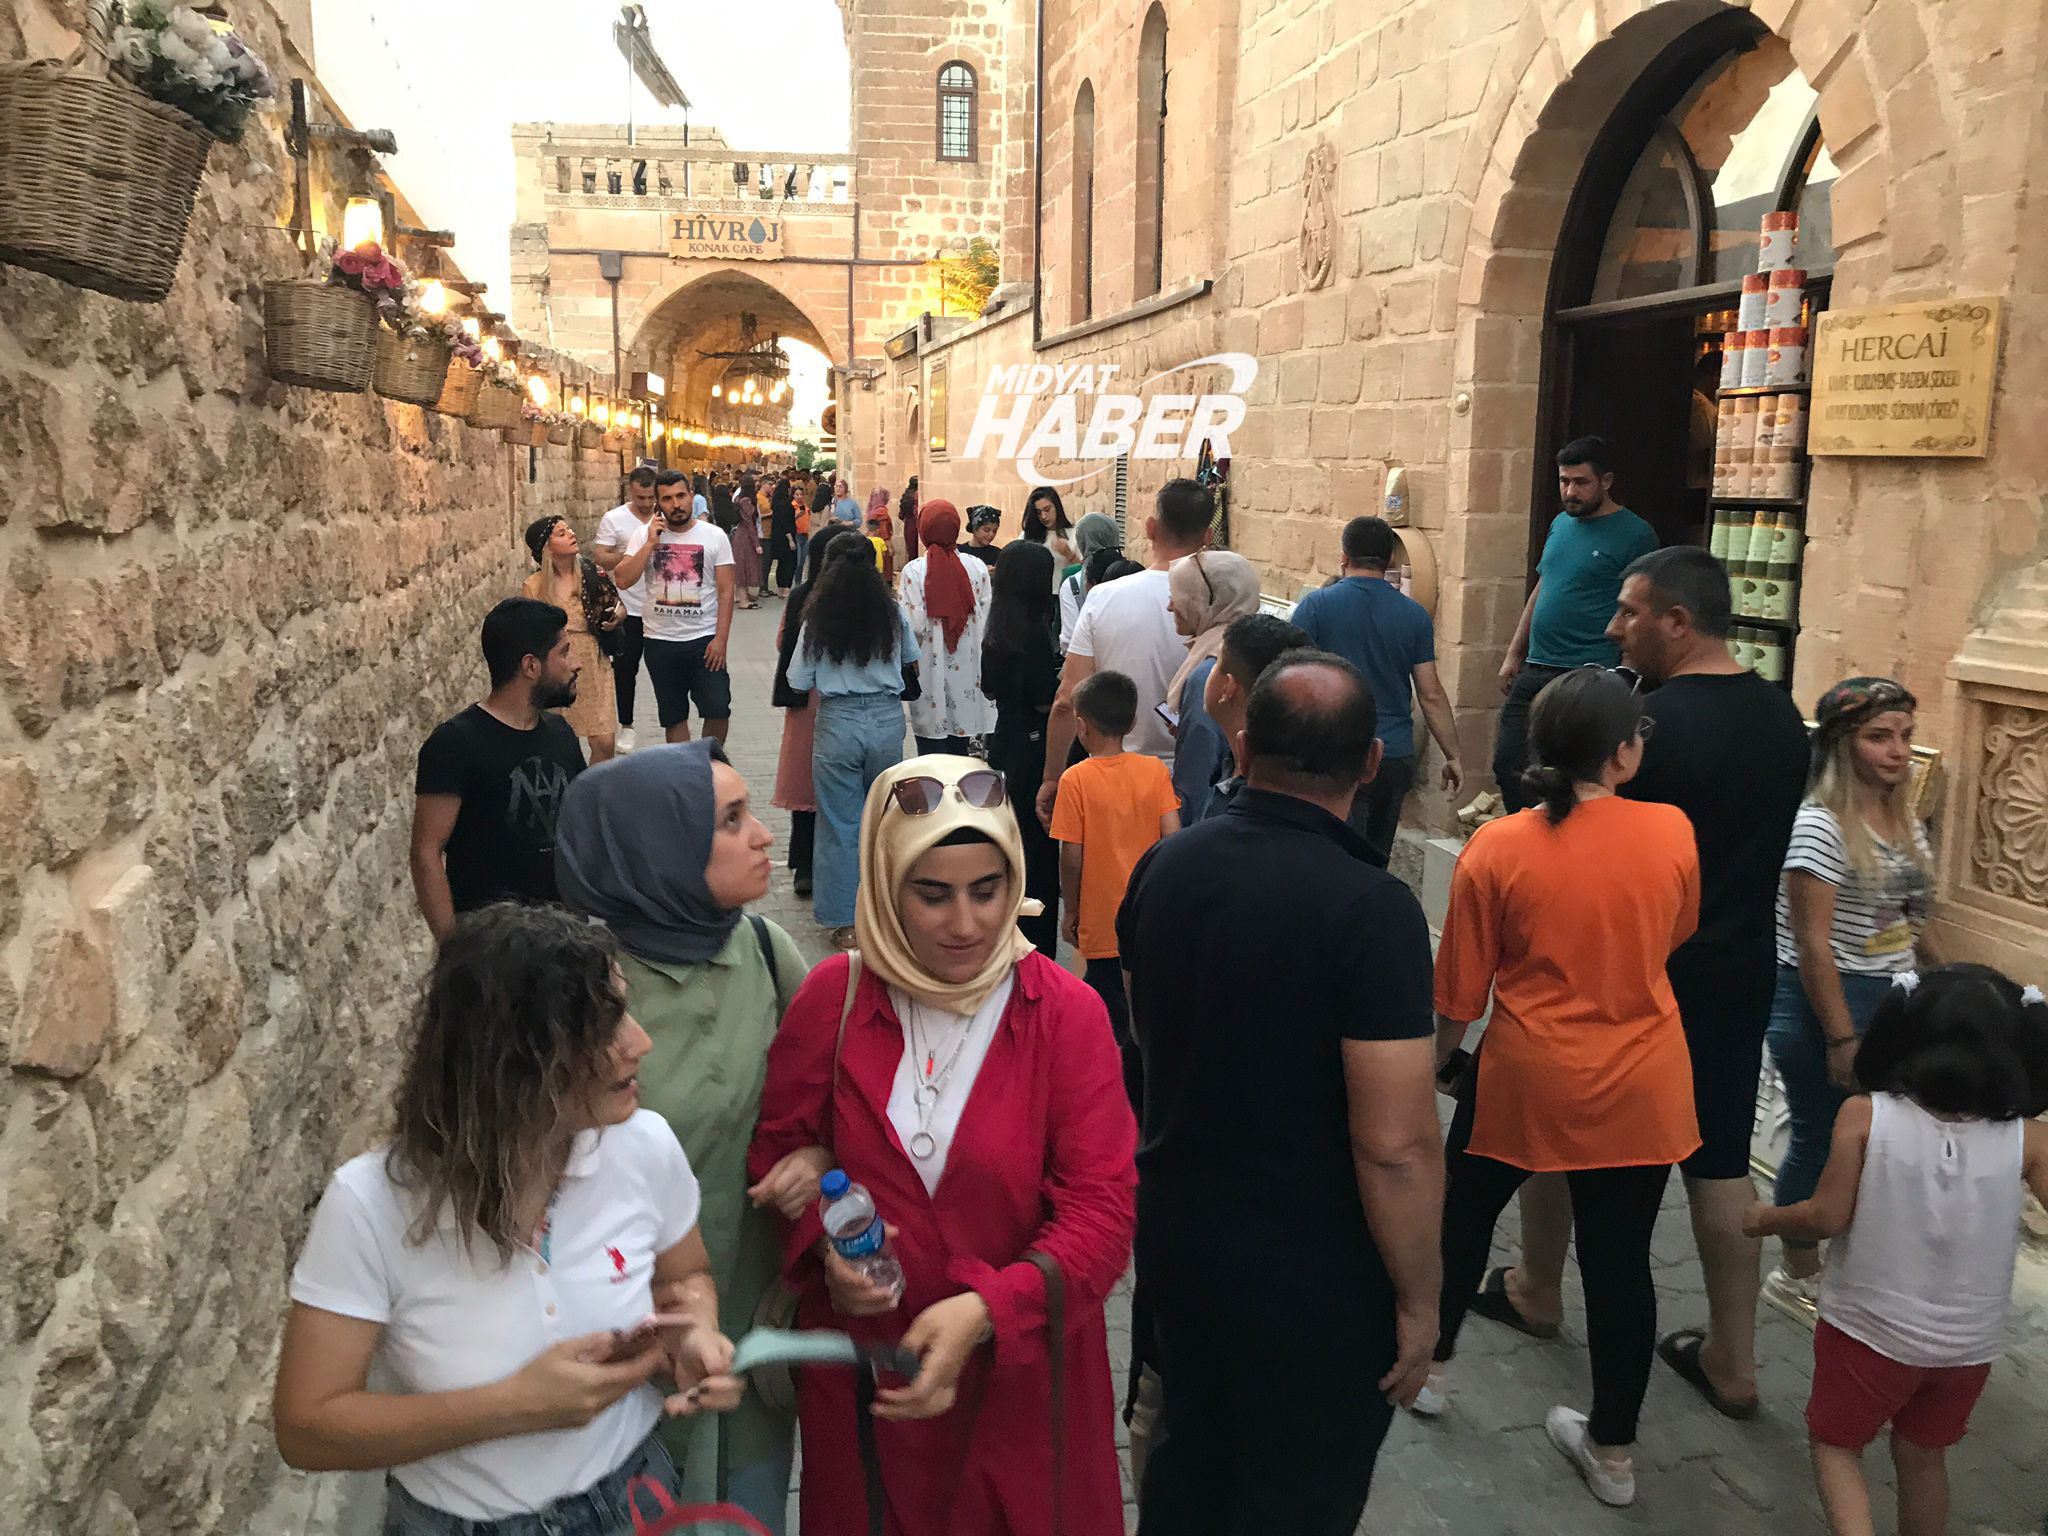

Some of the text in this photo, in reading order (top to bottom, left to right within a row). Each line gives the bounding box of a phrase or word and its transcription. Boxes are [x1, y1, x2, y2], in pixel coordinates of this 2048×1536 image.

[688, 243, 764, 254] KONAK CAFE
[654, 606, 704, 616] BAHAMAS
